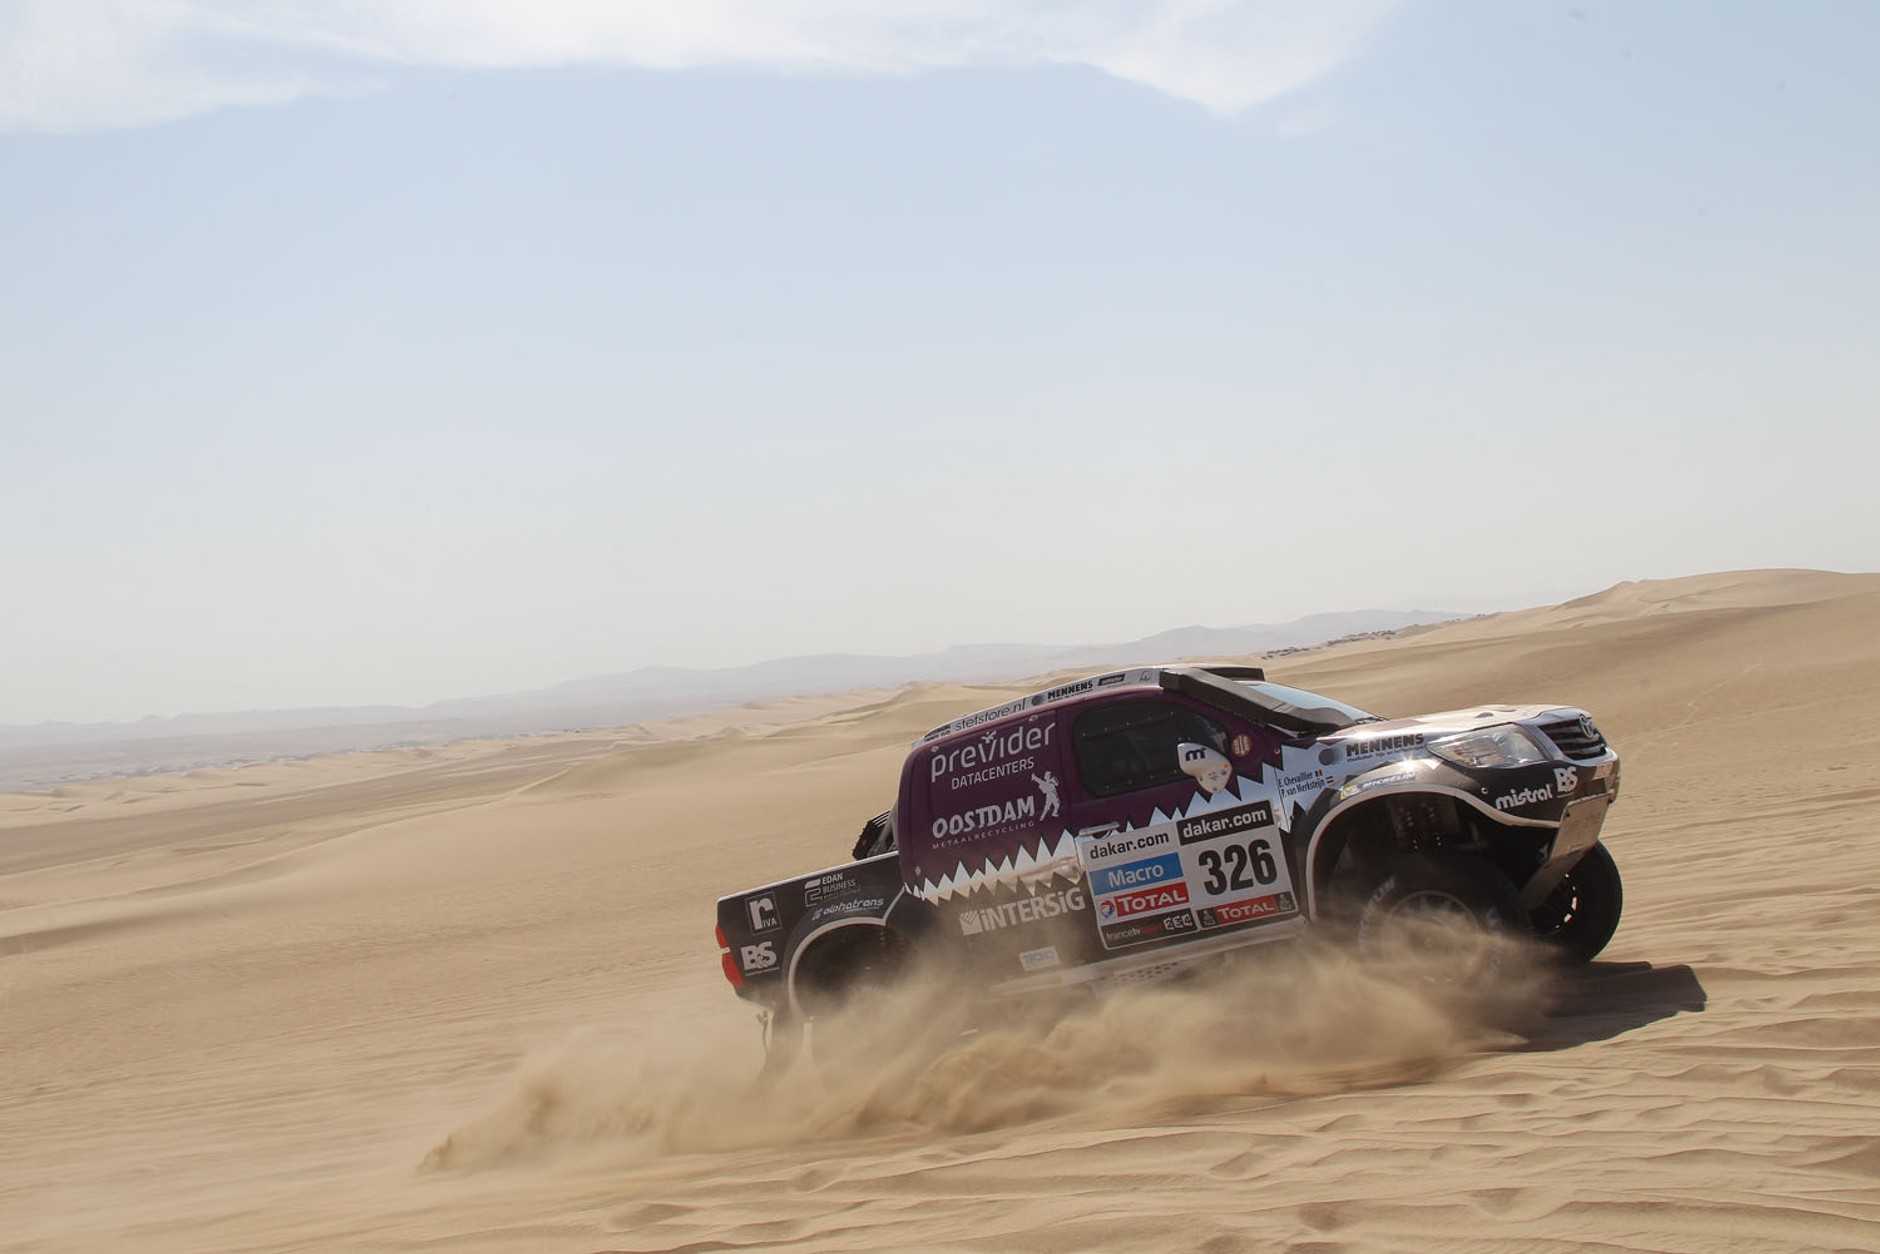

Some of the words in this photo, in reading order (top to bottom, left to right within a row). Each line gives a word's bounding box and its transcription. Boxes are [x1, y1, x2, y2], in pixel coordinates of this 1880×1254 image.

[1048, 680, 1093, 700] MENNENS
[955, 698, 1026, 731] stefstore.nl
[931, 722, 1056, 783] previder
[1346, 733, 1424, 757] MENNENS
[951, 757, 1034, 790] DATACENTERS
[1287, 786, 1296, 796] van
[1495, 783, 1553, 810] mistral
[932, 796, 1035, 838] OOSTDAM
[1183, 808, 1267, 838] dakar.com
[932, 822, 1034, 849] METAALRECYCLING
[1090, 831, 1169, 860] dakar.com
[822, 872, 844, 885] EDAN
[1108, 863, 1164, 888] Macro
[1198, 839, 1277, 896] 326
[822, 879, 856, 894] BUSINESS
